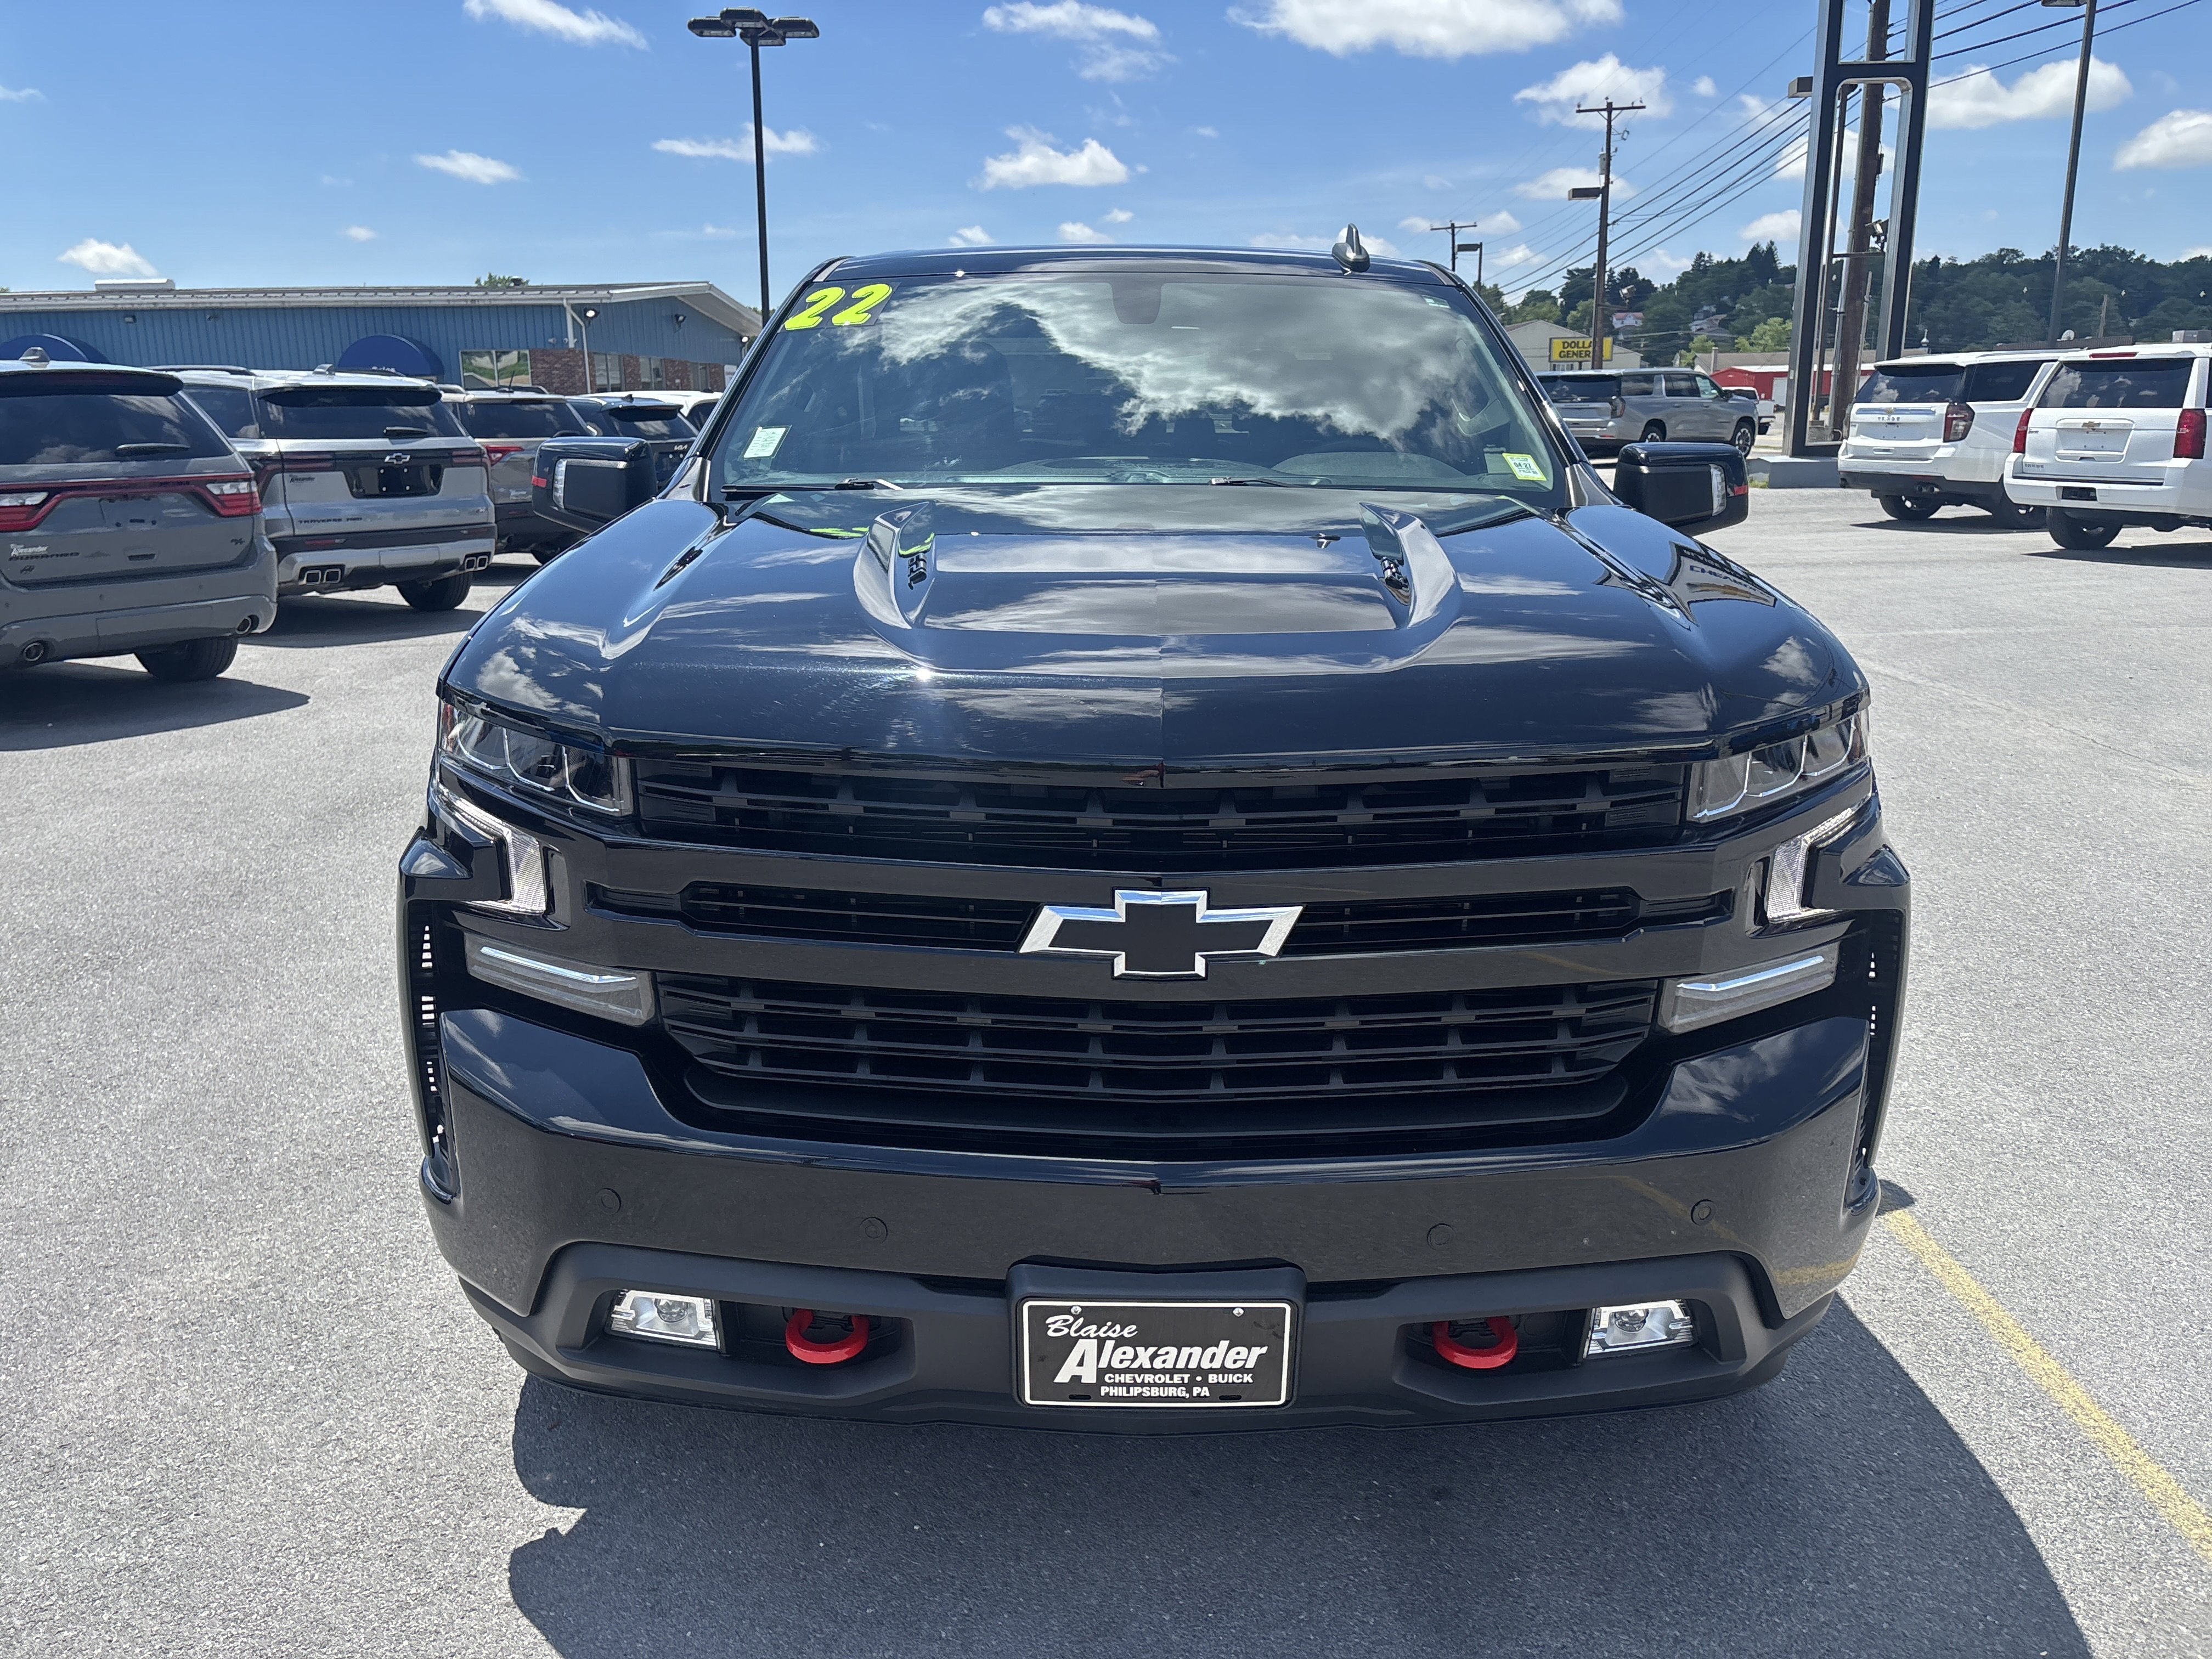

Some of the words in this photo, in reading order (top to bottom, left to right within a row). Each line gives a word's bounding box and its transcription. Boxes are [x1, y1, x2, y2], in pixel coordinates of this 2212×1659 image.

[785, 284, 893, 330] 22
[1562, 341, 1593, 349] DOLLA
[1559, 350, 1592, 358] GENER
[1045, 1314, 1138, 1338] Blaise
[1053, 1339, 1268, 1384] Alexander
[1104, 1373, 1190, 1384] CHEVROLET
[1208, 1373, 1254, 1384] BUICK
[1101, 1386, 1190, 1399] PHILIPSBURG,
[1193, 1386, 1210, 1397] PA
